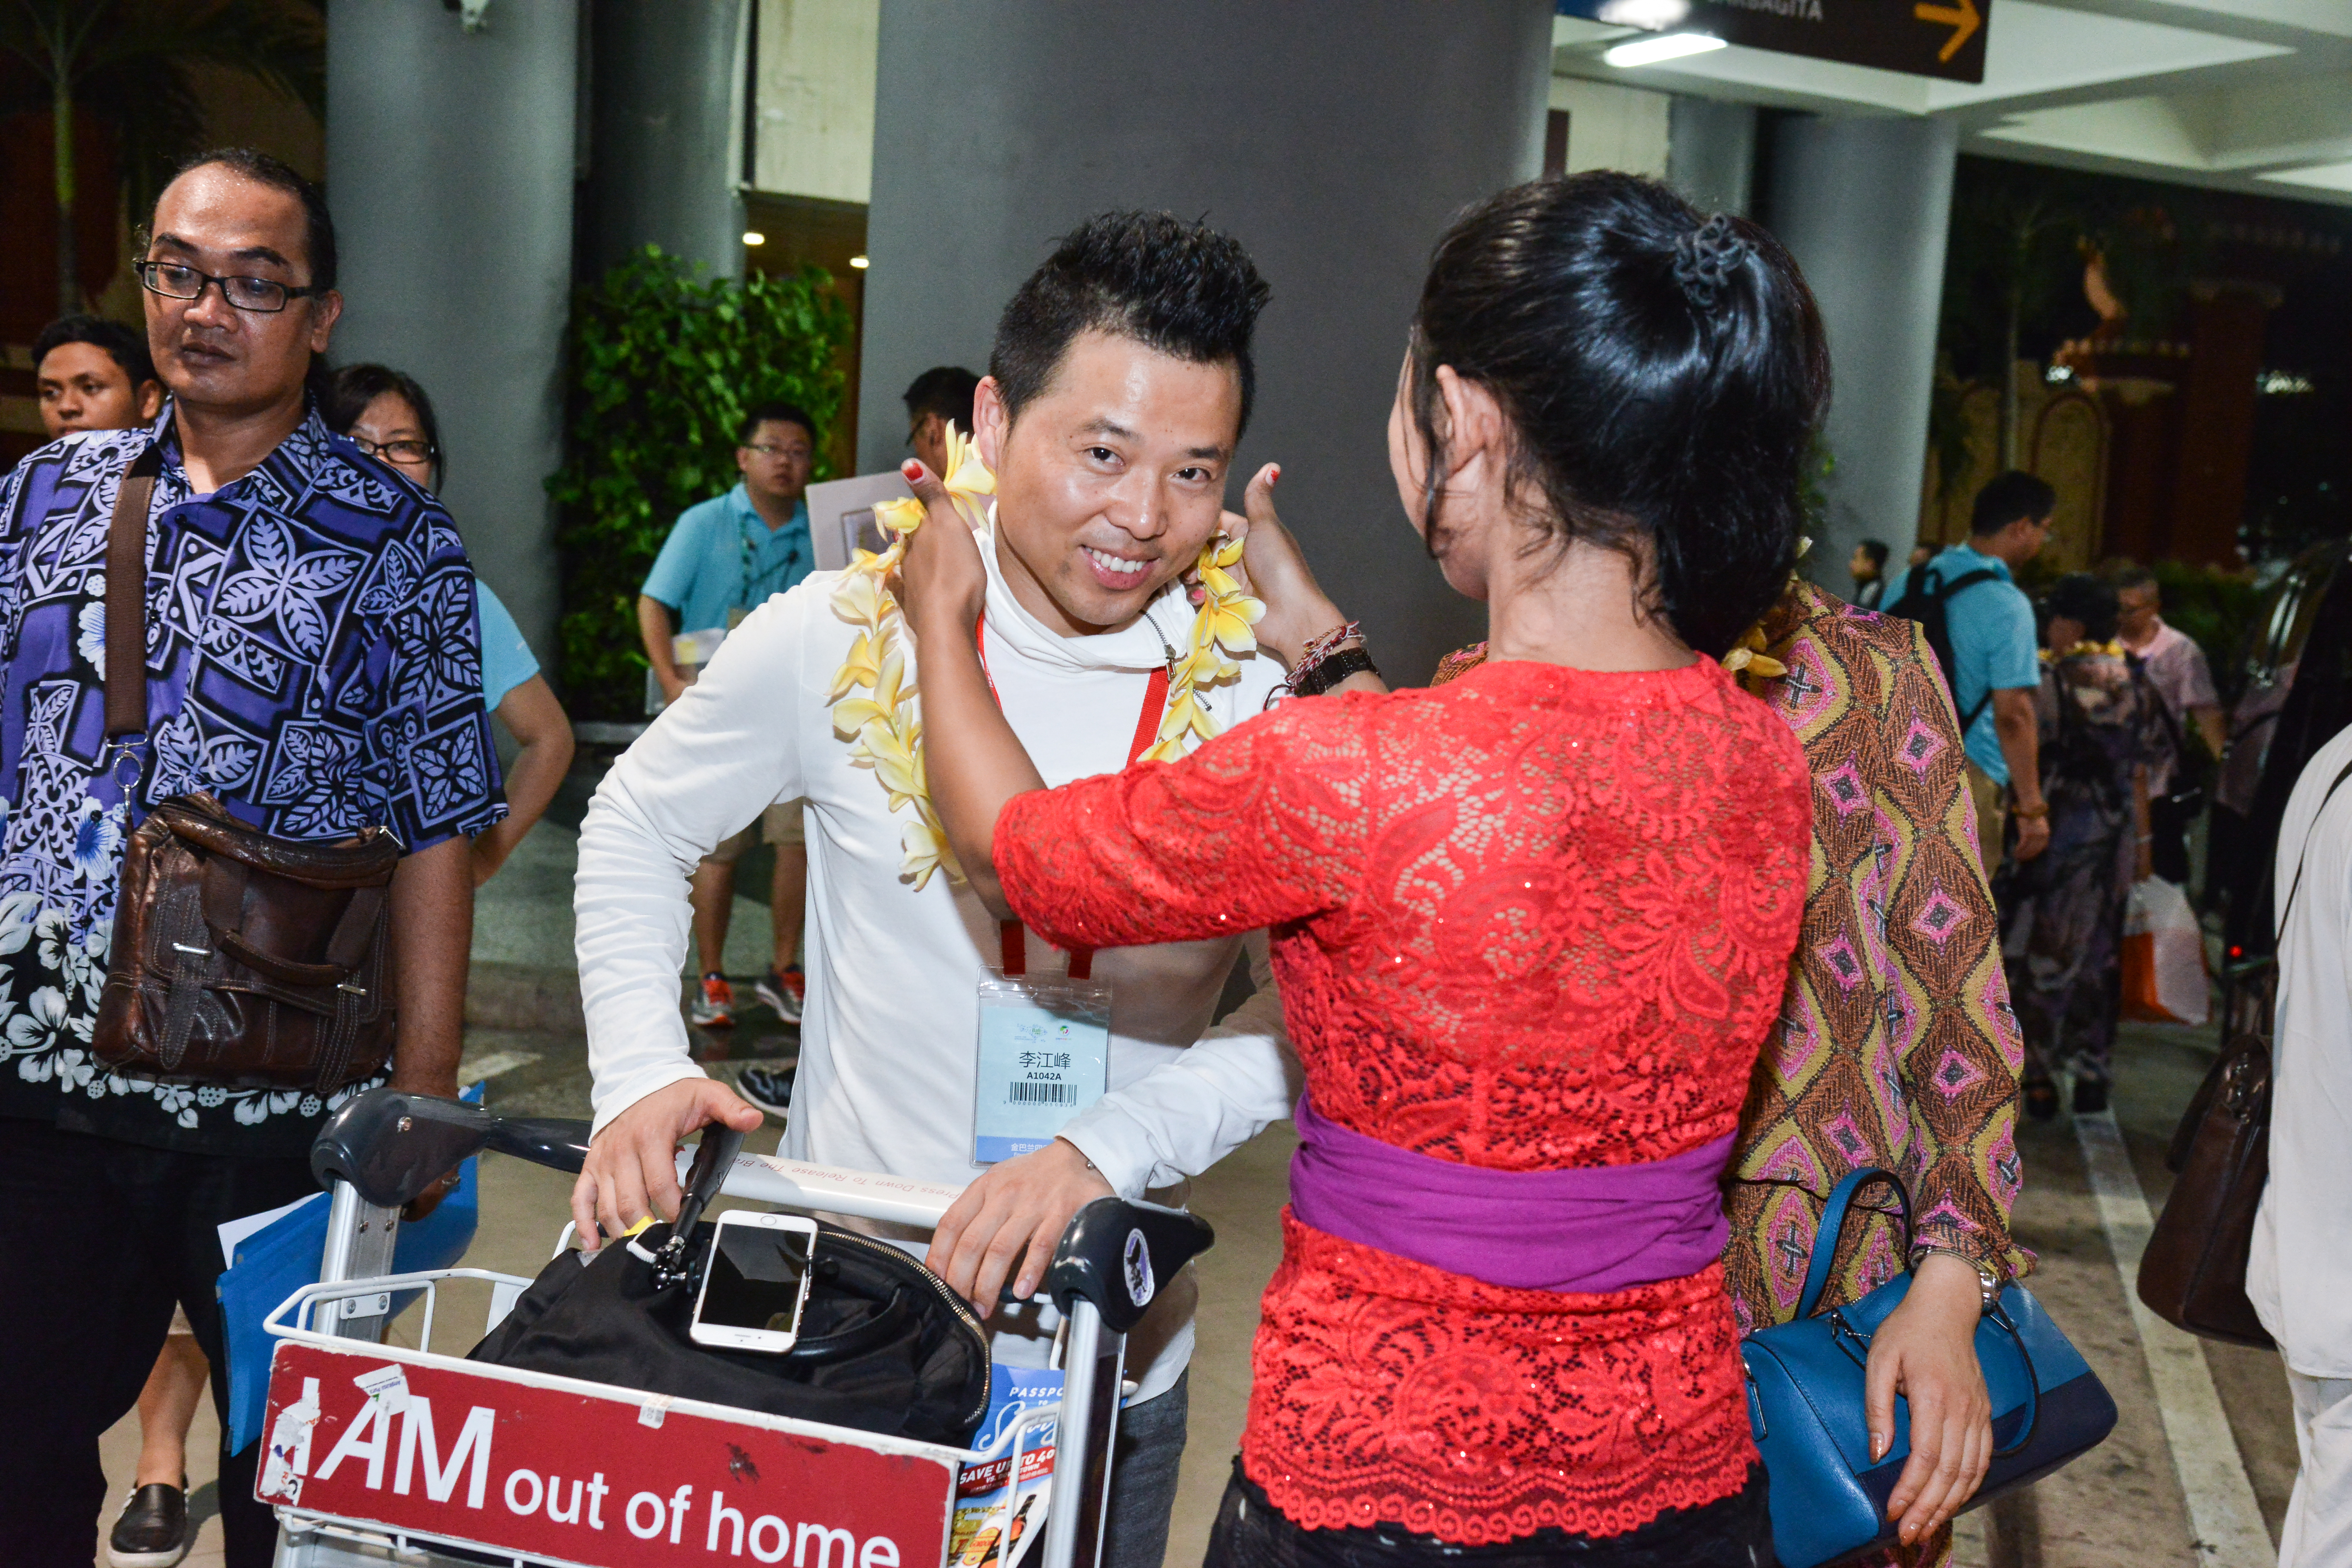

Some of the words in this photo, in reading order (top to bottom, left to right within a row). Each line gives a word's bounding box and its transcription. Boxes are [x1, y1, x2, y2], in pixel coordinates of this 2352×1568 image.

[1019, 1051, 1071, 1069] 李江峰
[1027, 1072, 1061, 1080] A1042A
[1011, 1143, 1047, 1152] 金巴兰四
[760, 1162, 784, 1172] The
[792, 1167, 848, 1182] Release
[875, 1180, 914, 1192] Down
[920, 1187, 960, 1199] Press
[292, 1377, 320, 1476] I
[314, 1394, 495, 1509] AM
[504, 1468, 609, 1531] out
[625, 1484, 693, 1544] of
[706, 1490, 900, 1568] home
[960, 1464, 994, 1484] SAVE
[1020, 1453, 1036, 1467] TO
[1037, 1449, 1055, 1463] 40
